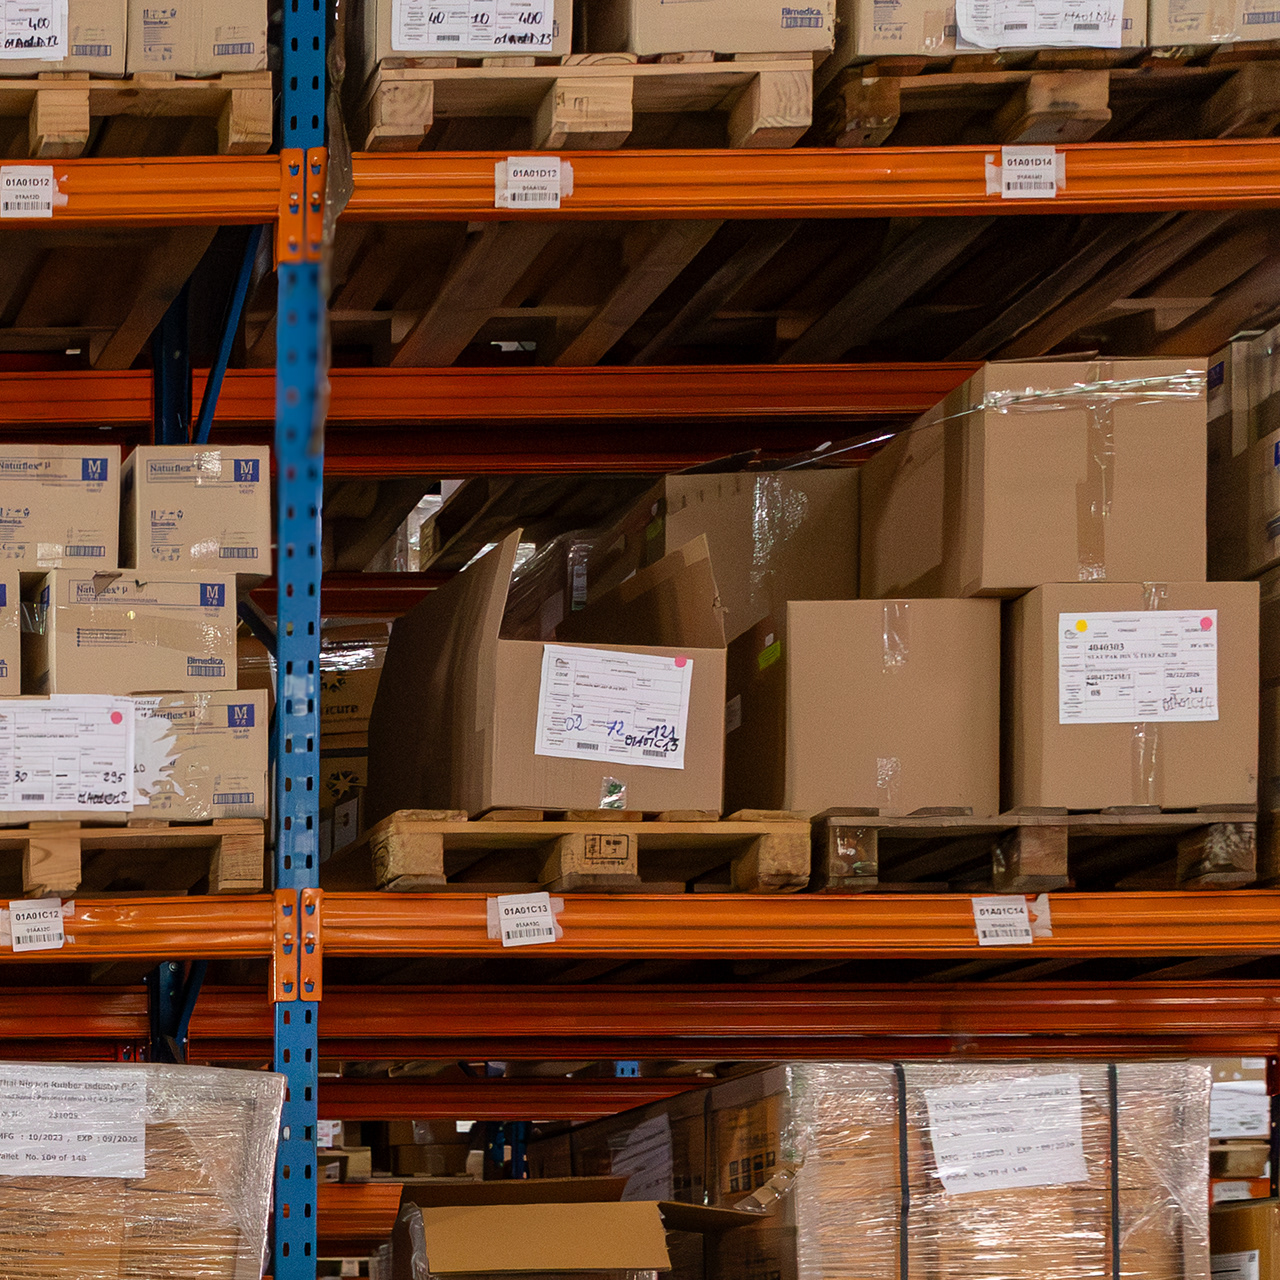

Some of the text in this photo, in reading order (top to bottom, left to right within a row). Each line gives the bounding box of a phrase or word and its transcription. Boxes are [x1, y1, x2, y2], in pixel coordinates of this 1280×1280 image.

[28, 17, 50, 29] 400
[429, 11, 446, 24] 40
[519, 11, 543, 24] 400
[1007, 159, 1052, 167] 01A01D14
[5, 178, 49, 187] 01A01D12
[88, 460, 101, 473] M
[240, 461, 253, 474] M
[206, 586, 219, 598] M
[234, 707, 248, 719] M
[15, 911, 59, 921] 01A01C12
[504, 906, 547, 915] 01A01C13
[28, 1134, 63, 1143] 10/2023
[102, 1135, 138, 1144] 09/2026
